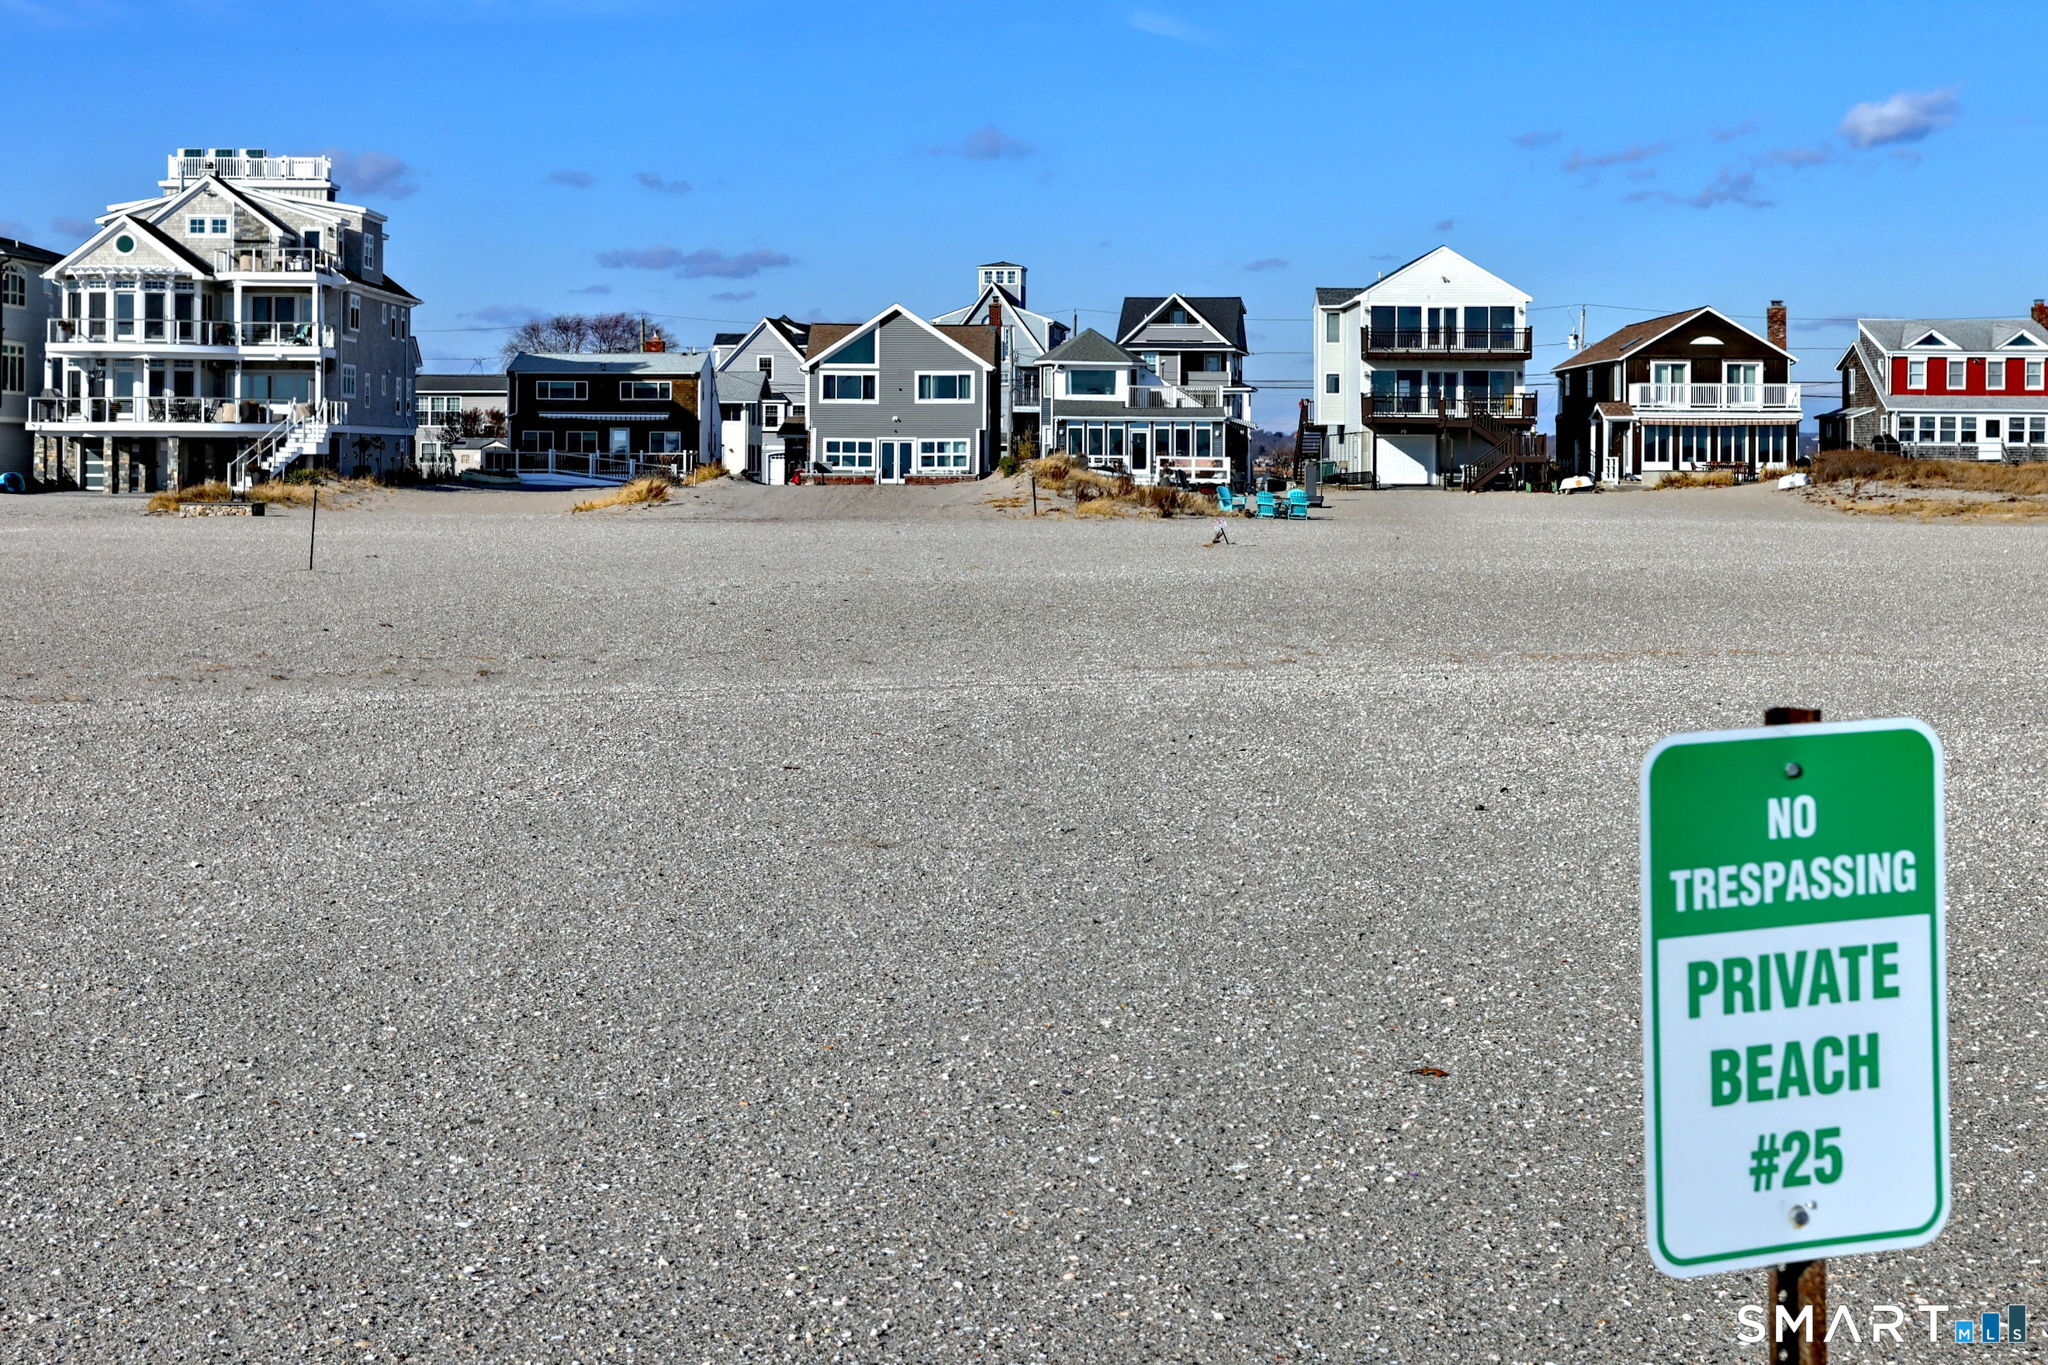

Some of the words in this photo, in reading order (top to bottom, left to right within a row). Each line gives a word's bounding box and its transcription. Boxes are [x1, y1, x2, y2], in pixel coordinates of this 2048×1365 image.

[1767, 794, 1817, 840] NO
[1669, 850, 1917, 912] TRESPASSING
[1687, 942, 1900, 1019] PRIVATE
[1710, 1032, 1880, 1107] BEACH
[1749, 1127, 1843, 1192] #25
